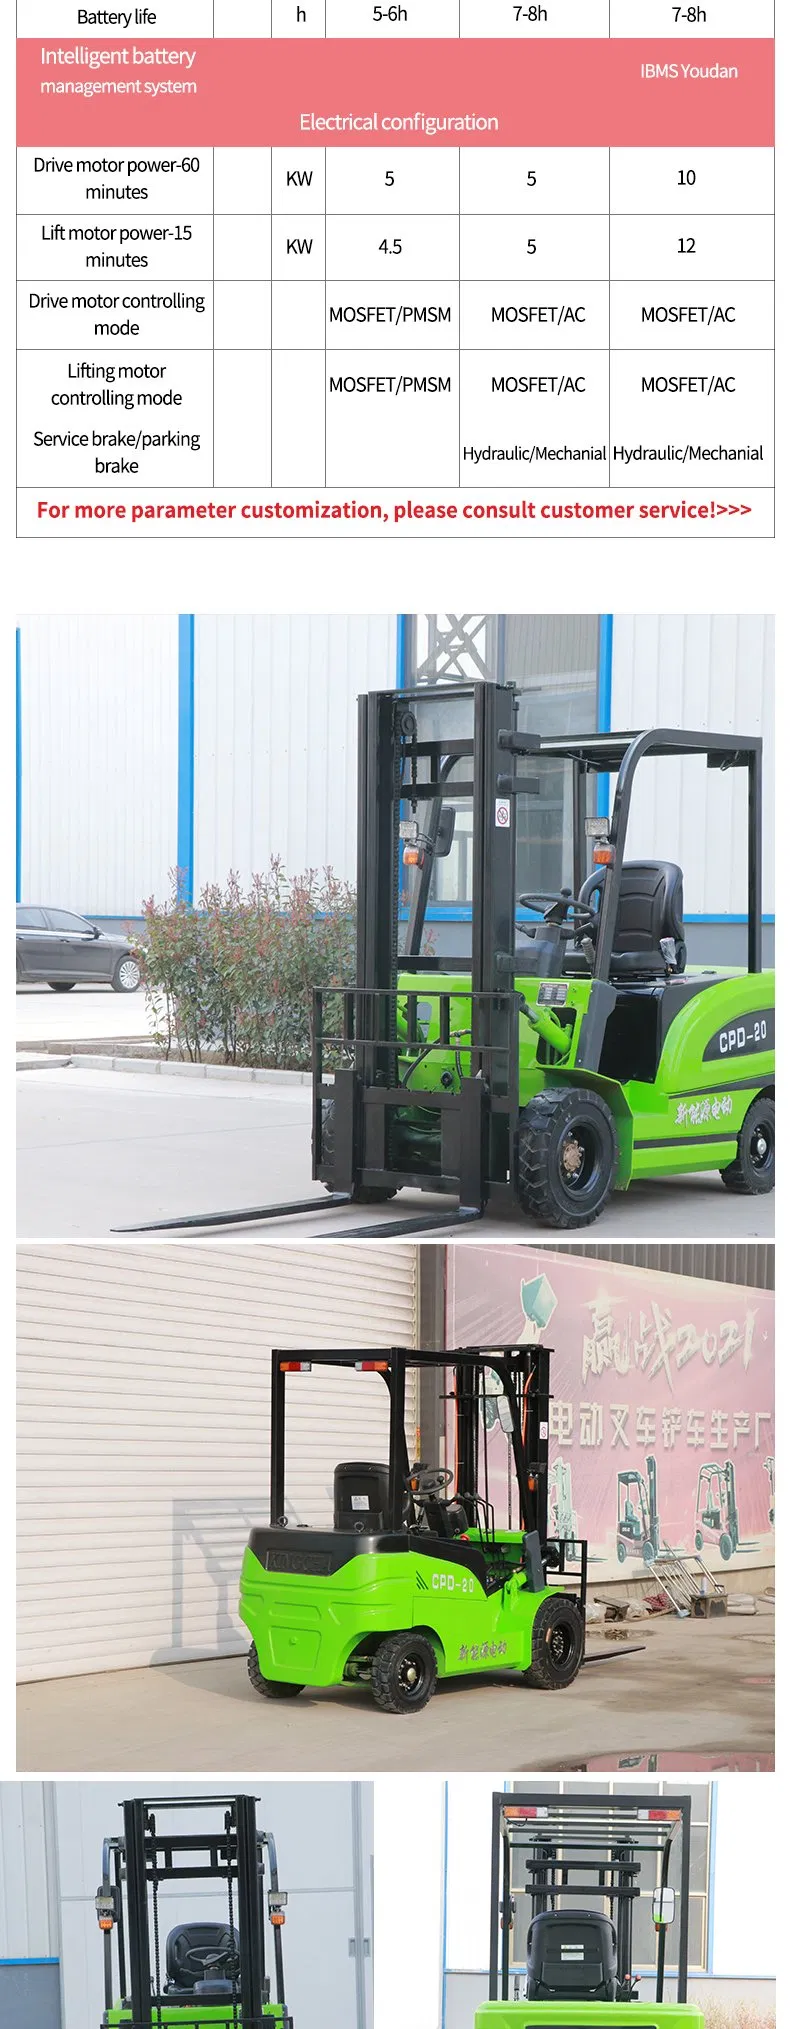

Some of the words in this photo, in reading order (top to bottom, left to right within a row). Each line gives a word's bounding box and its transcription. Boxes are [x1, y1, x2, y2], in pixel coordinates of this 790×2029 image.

[719, 1020, 767, 1053] CPD-20
[675, 1095, 733, 1127] 新能源电动
[549, 1401, 772, 1450] 电动叉车铲车生产厂
[432, 1573, 474, 1593] CPD-20
